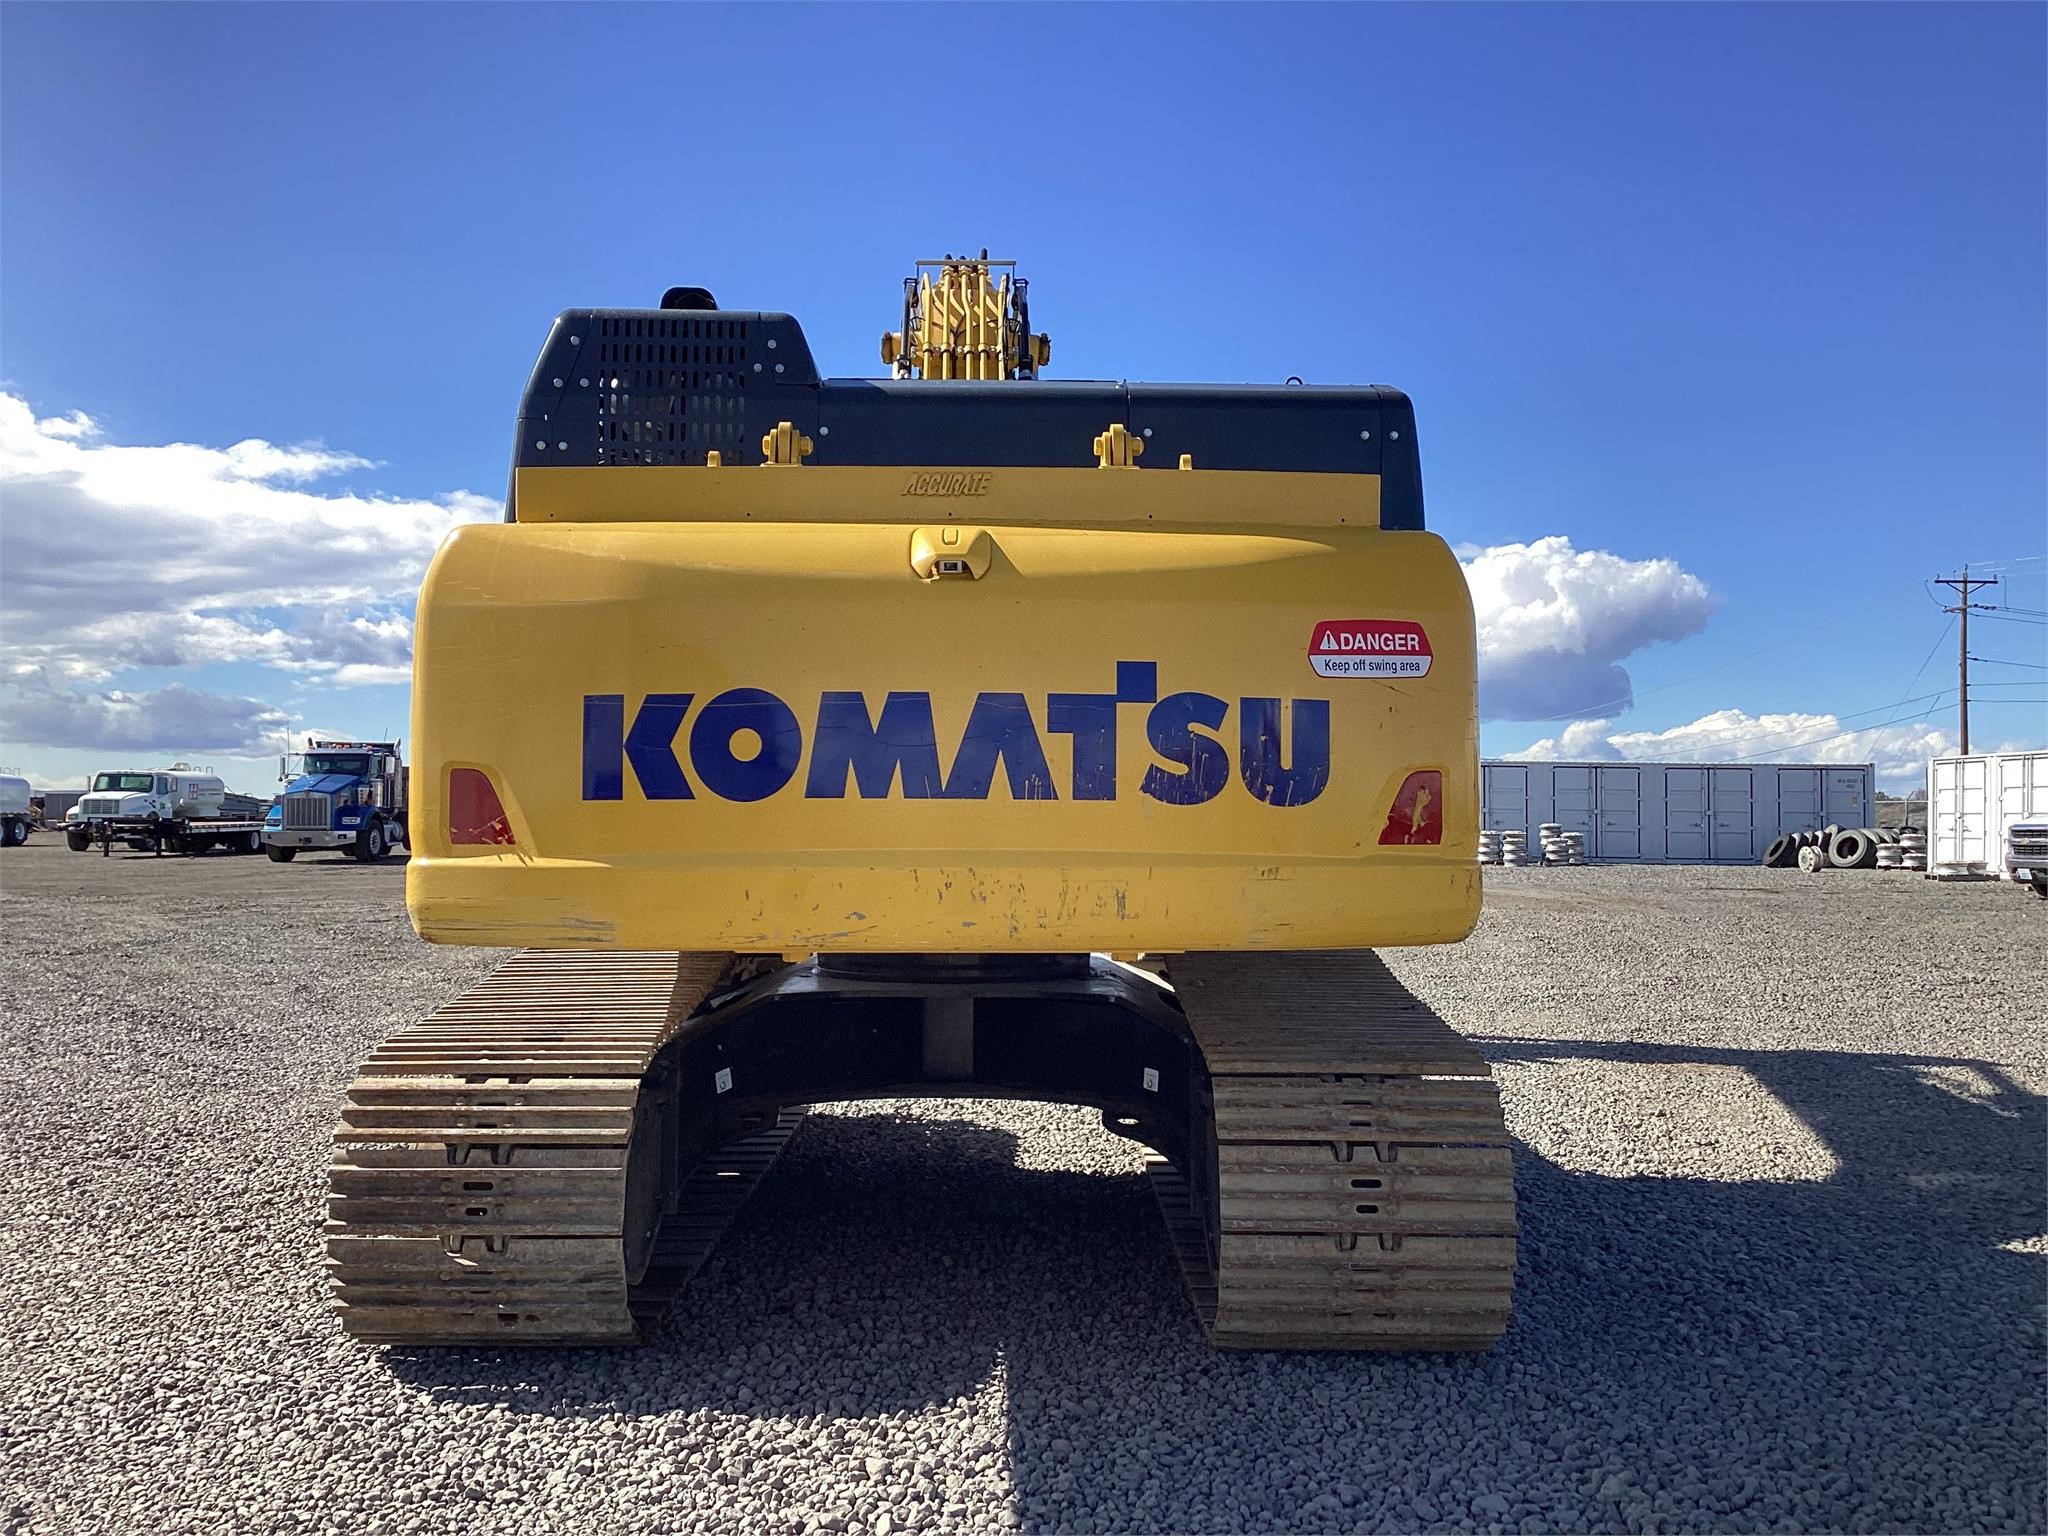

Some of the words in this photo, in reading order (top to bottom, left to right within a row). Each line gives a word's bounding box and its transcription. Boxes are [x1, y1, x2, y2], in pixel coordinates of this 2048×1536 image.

[900, 472, 993, 496] ACCURATE
[1340, 632, 1420, 651] DANGER
[1324, 659, 1350, 674] Keep
[1352, 659, 1367, 672] off
[1368, 659, 1397, 674] swing
[1399, 661, 1421, 672] area
[582, 661, 1331, 807] KOMATSU
